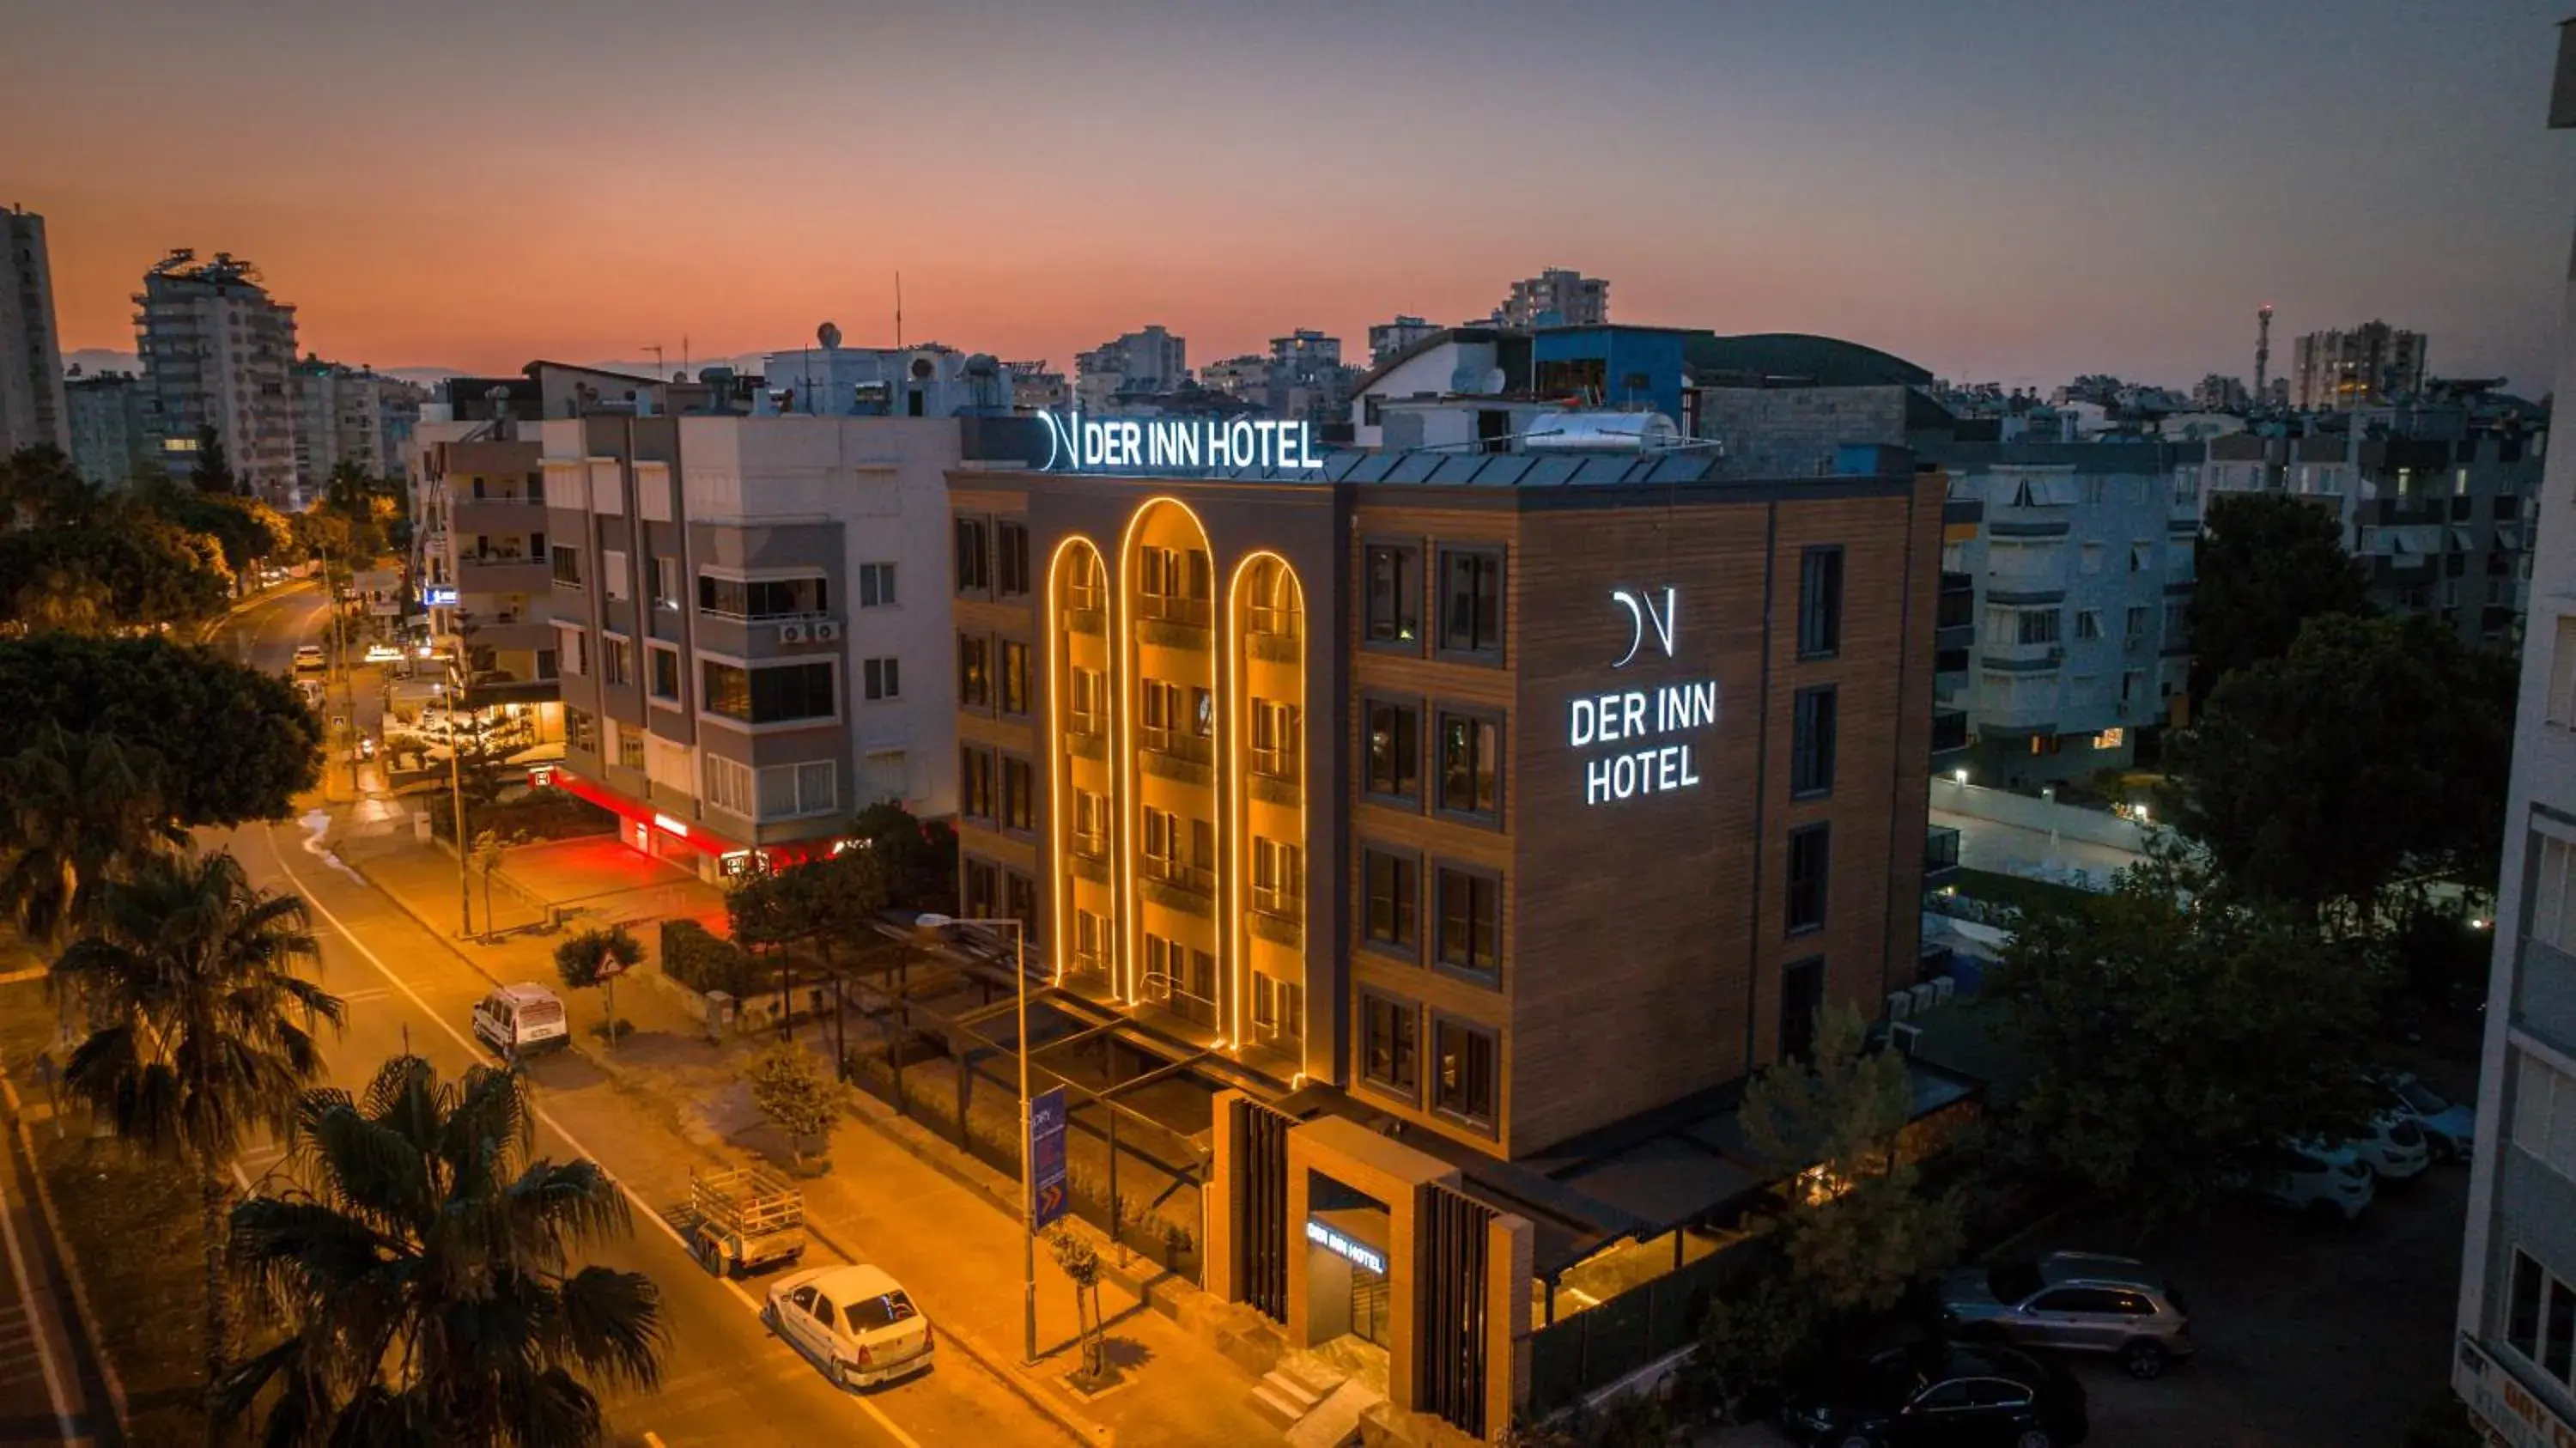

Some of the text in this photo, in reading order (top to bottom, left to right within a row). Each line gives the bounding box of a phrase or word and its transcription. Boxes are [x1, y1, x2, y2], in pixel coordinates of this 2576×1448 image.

[1084, 421, 1143, 466] DER
[1148, 421, 1200, 467] INN
[1208, 419, 1323, 469] HOTEL
[1571, 680, 1716, 747] DER INN
[1588, 745, 1700, 806] HOTEL
[1348, 1243, 1384, 1275] HOTEL
